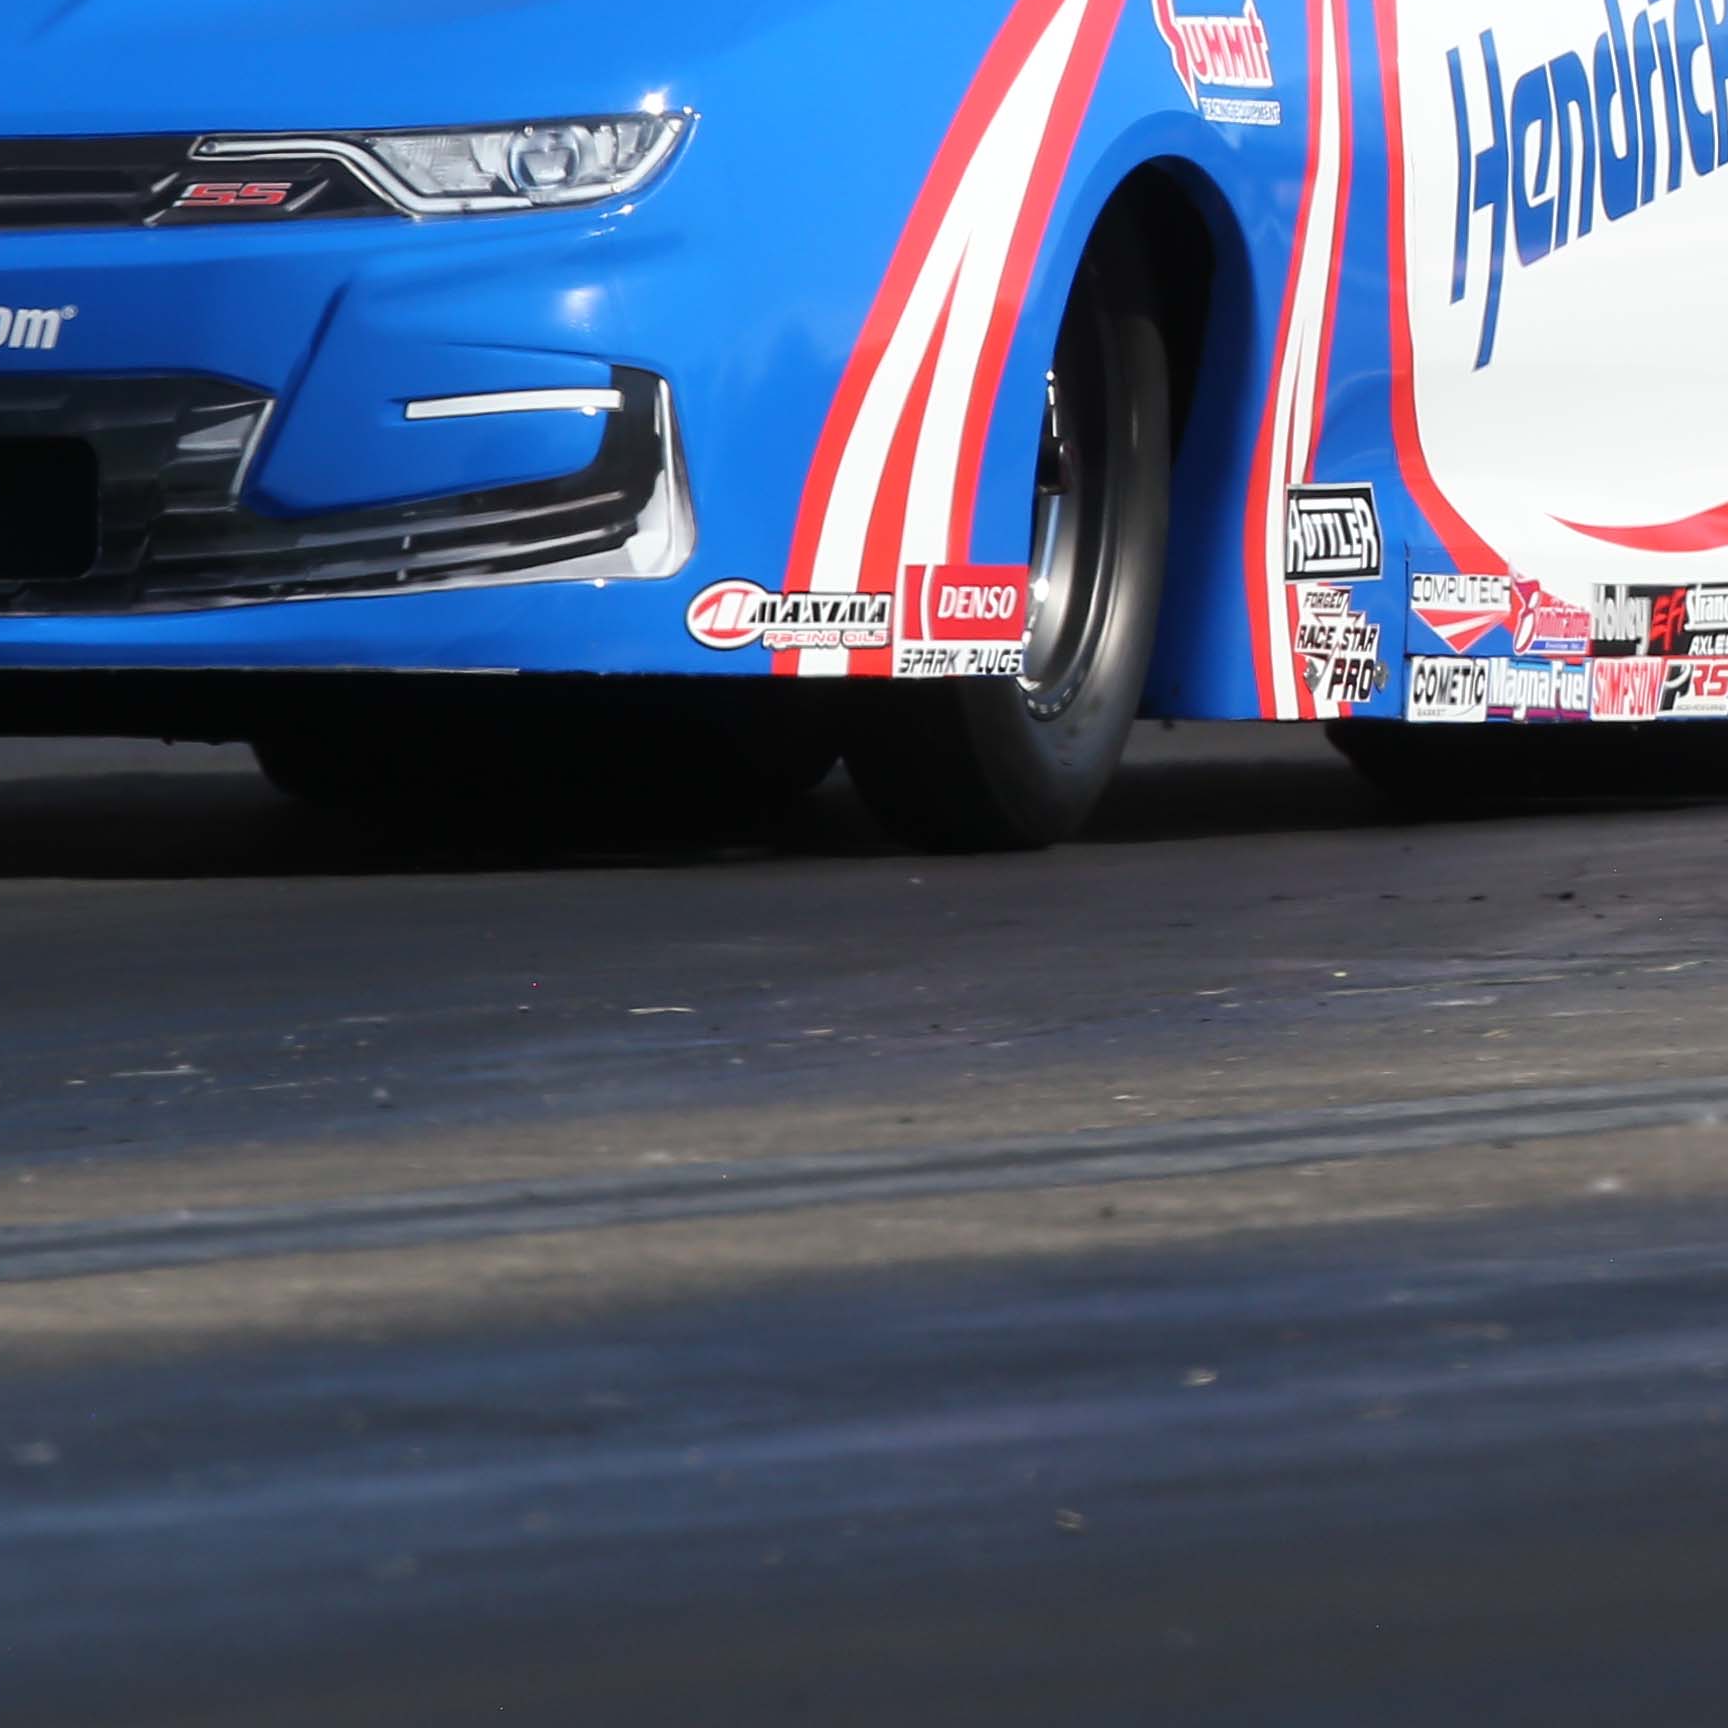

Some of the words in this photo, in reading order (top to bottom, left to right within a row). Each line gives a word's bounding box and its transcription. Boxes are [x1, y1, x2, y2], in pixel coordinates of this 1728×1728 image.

[173, 182, 292, 207] SS
[1286, 496, 1379, 573] ROTTLER
[937, 584, 1018, 621] DENSO
[1303, 591, 1346, 609] FORGED
[1410, 575, 1512, 606] COMPUTECH
[748, 593, 888, 625] MAXIMA
[1593, 584, 1651, 655] Holley
[762, 631, 839, 647] RACING
[844, 631, 888, 647] OILS
[1296, 624, 1336, 650] RACE
[1340, 625, 1378, 652] STAR
[898, 648, 960, 674] SPARK
[965, 647, 1023, 674] PLUGS
[1326, 657, 1375, 701] PRO
[1412, 662, 1487, 706] COMETIC
[1487, 656, 1589, 720] MagnaFuel
[1592, 658, 1663, 717] SIMPSON
